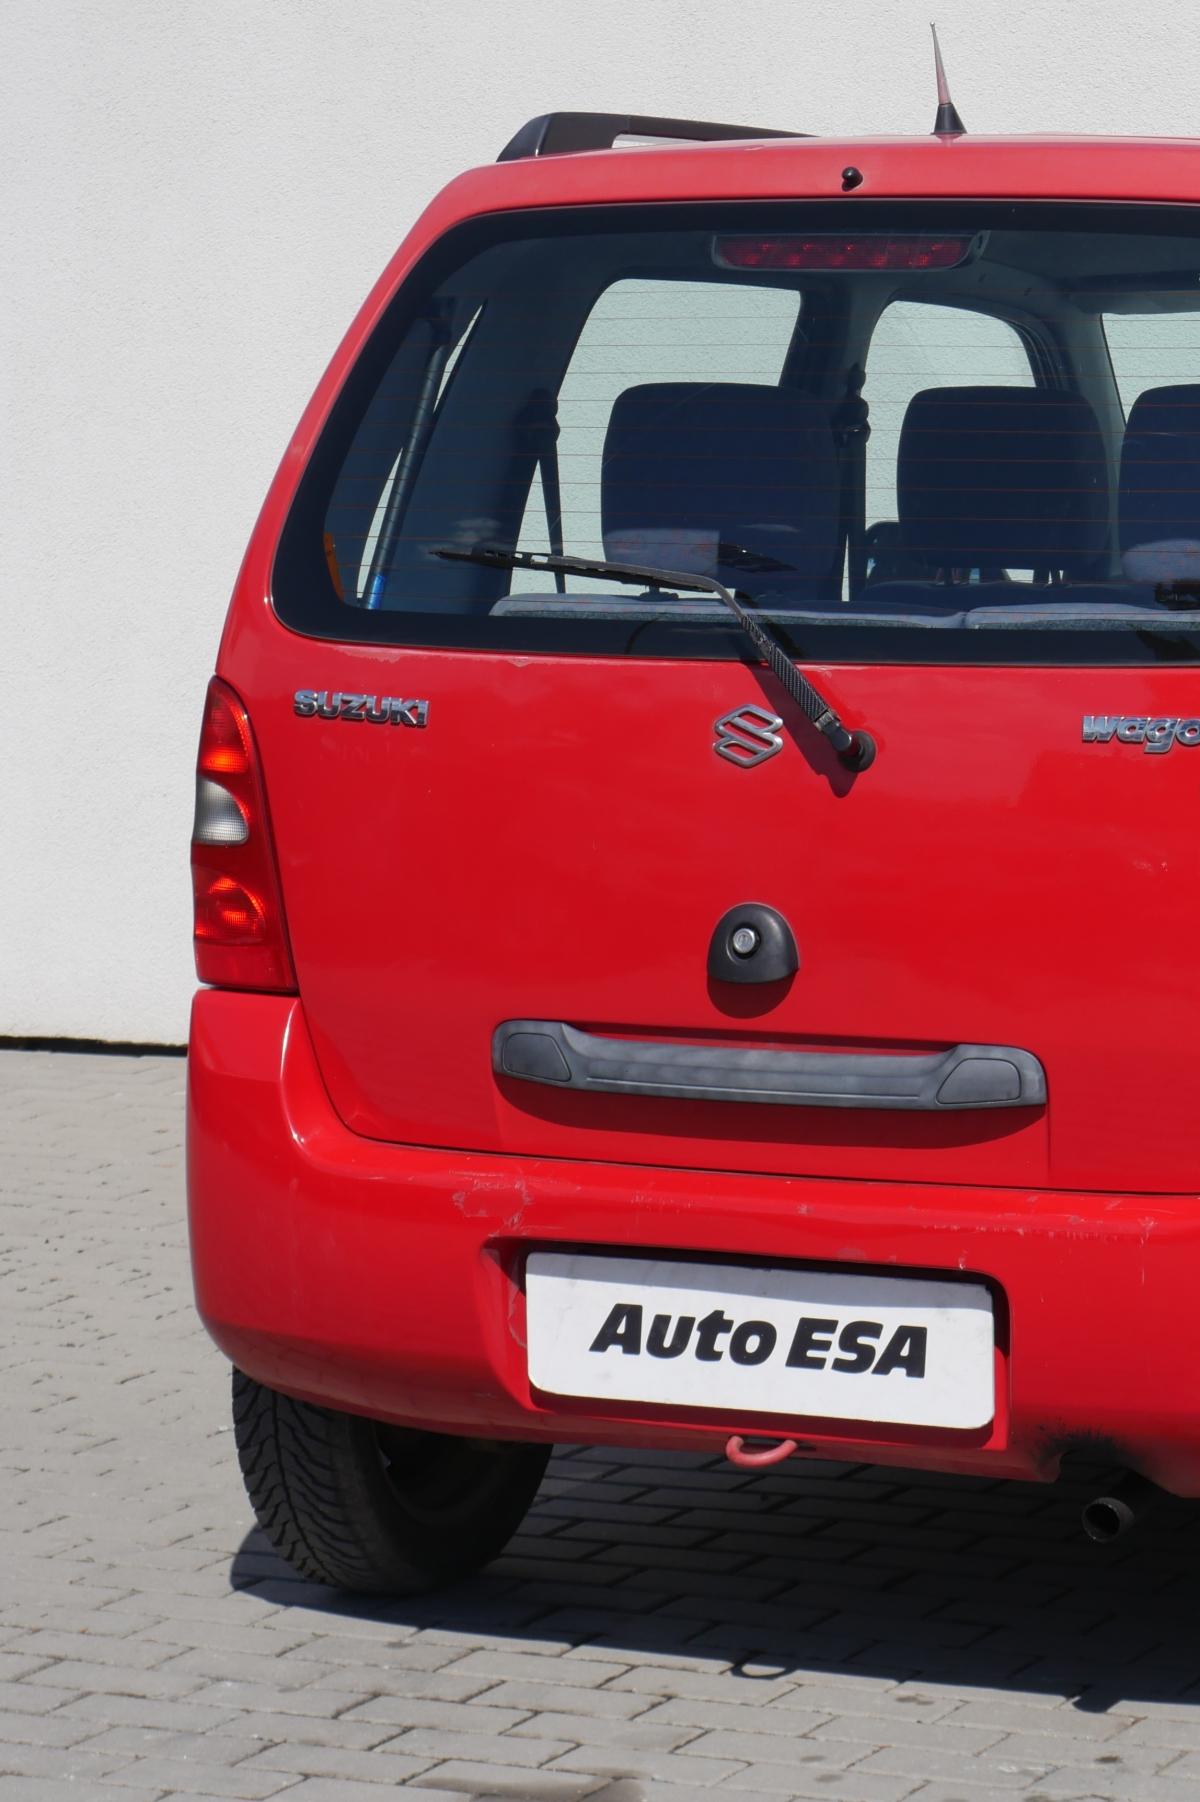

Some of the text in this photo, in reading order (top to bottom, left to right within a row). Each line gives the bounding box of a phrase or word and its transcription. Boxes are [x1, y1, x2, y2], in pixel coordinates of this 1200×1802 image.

[294, 689, 429, 727] SUZUKI
[589, 1303, 928, 1379] Auto ESA
